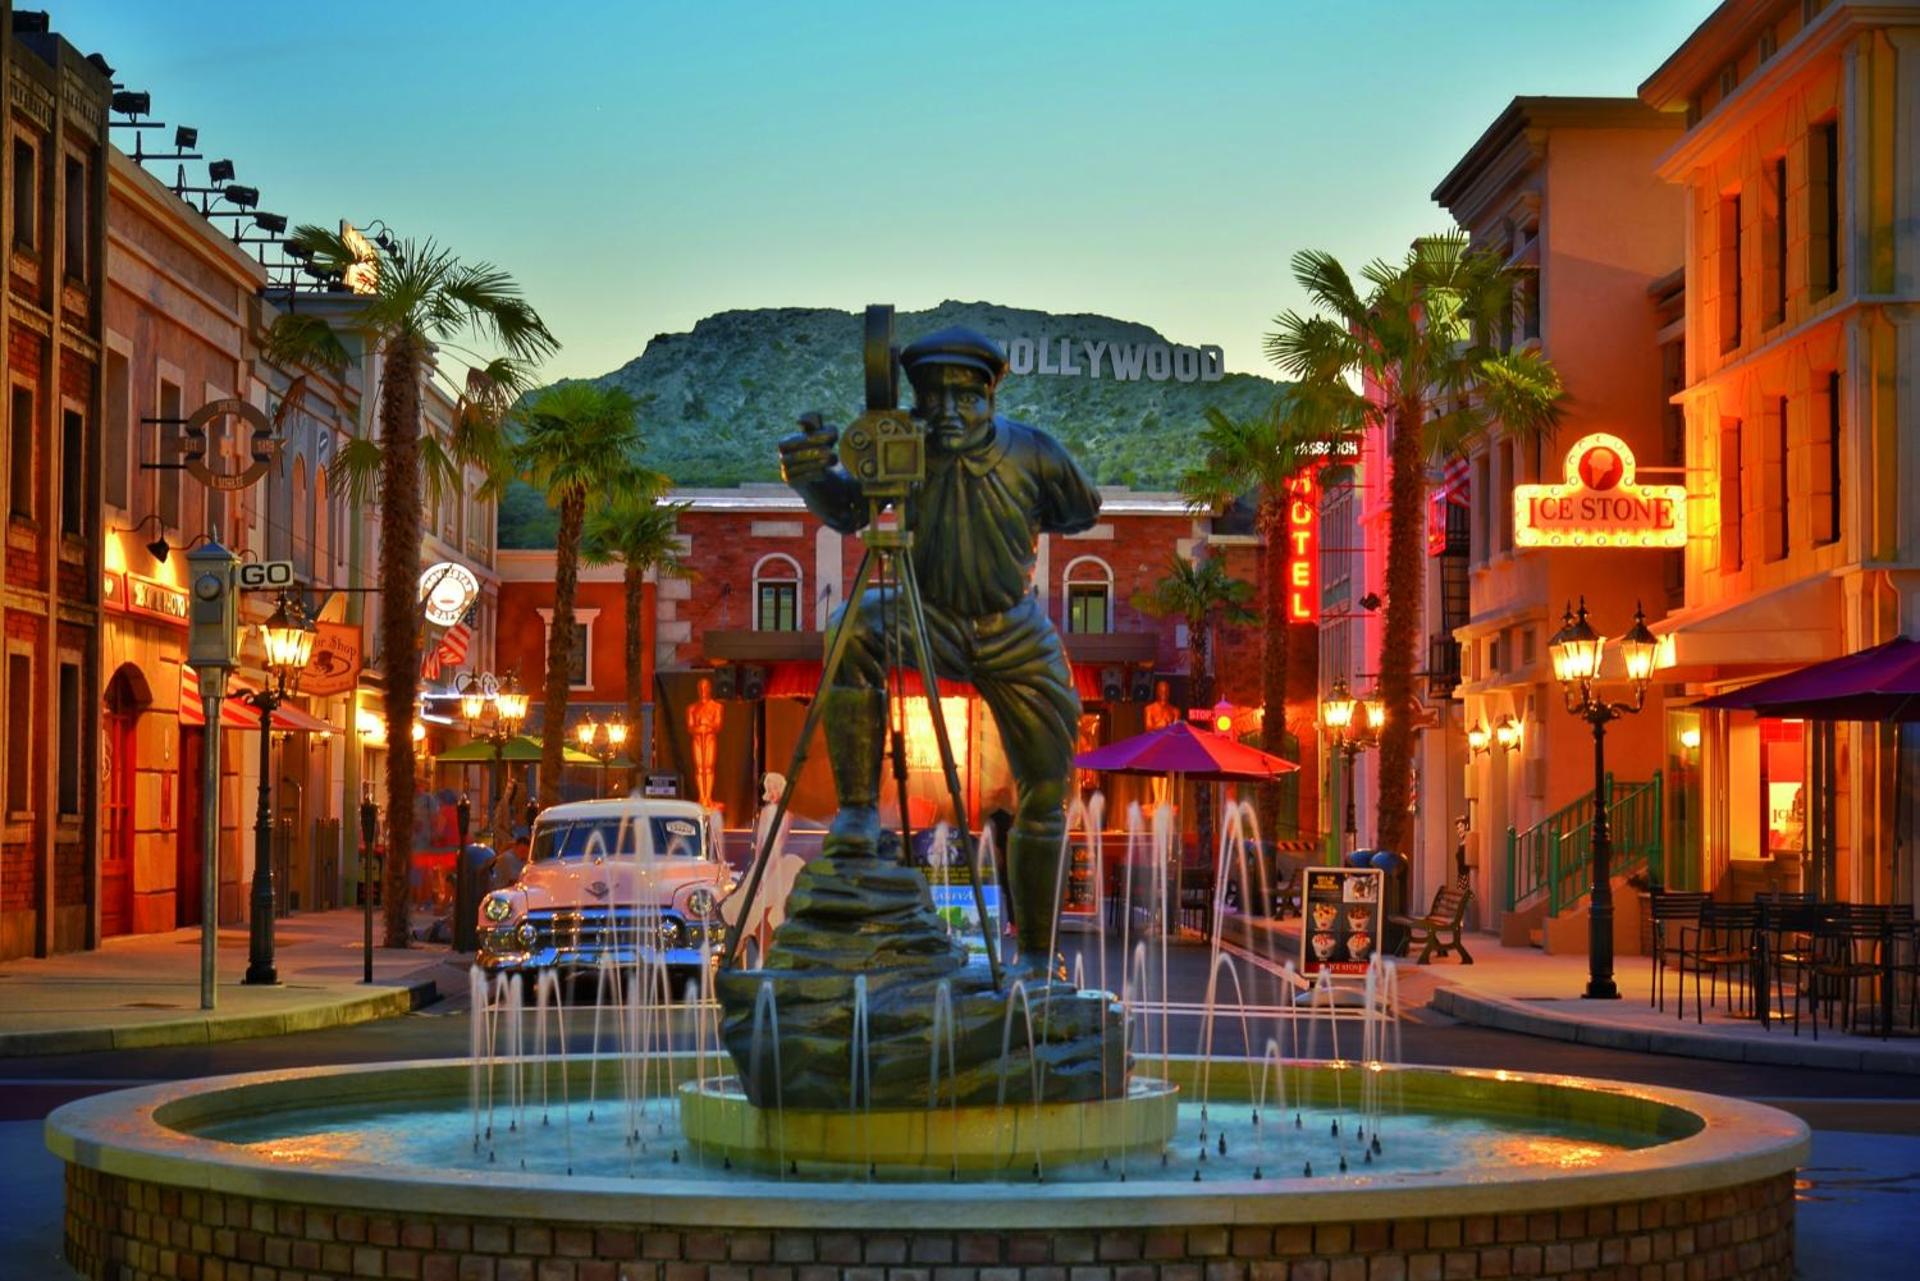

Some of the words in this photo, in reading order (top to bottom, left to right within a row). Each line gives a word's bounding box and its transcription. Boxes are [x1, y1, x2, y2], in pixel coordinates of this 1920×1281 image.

[1000, 336, 1225, 383] OLLYWOOD
[1527, 497, 1573, 528] ICE
[1580, 497, 1675, 529] STONE
[241, 563, 291, 585] GO
[328, 634, 357, 661] Shop
